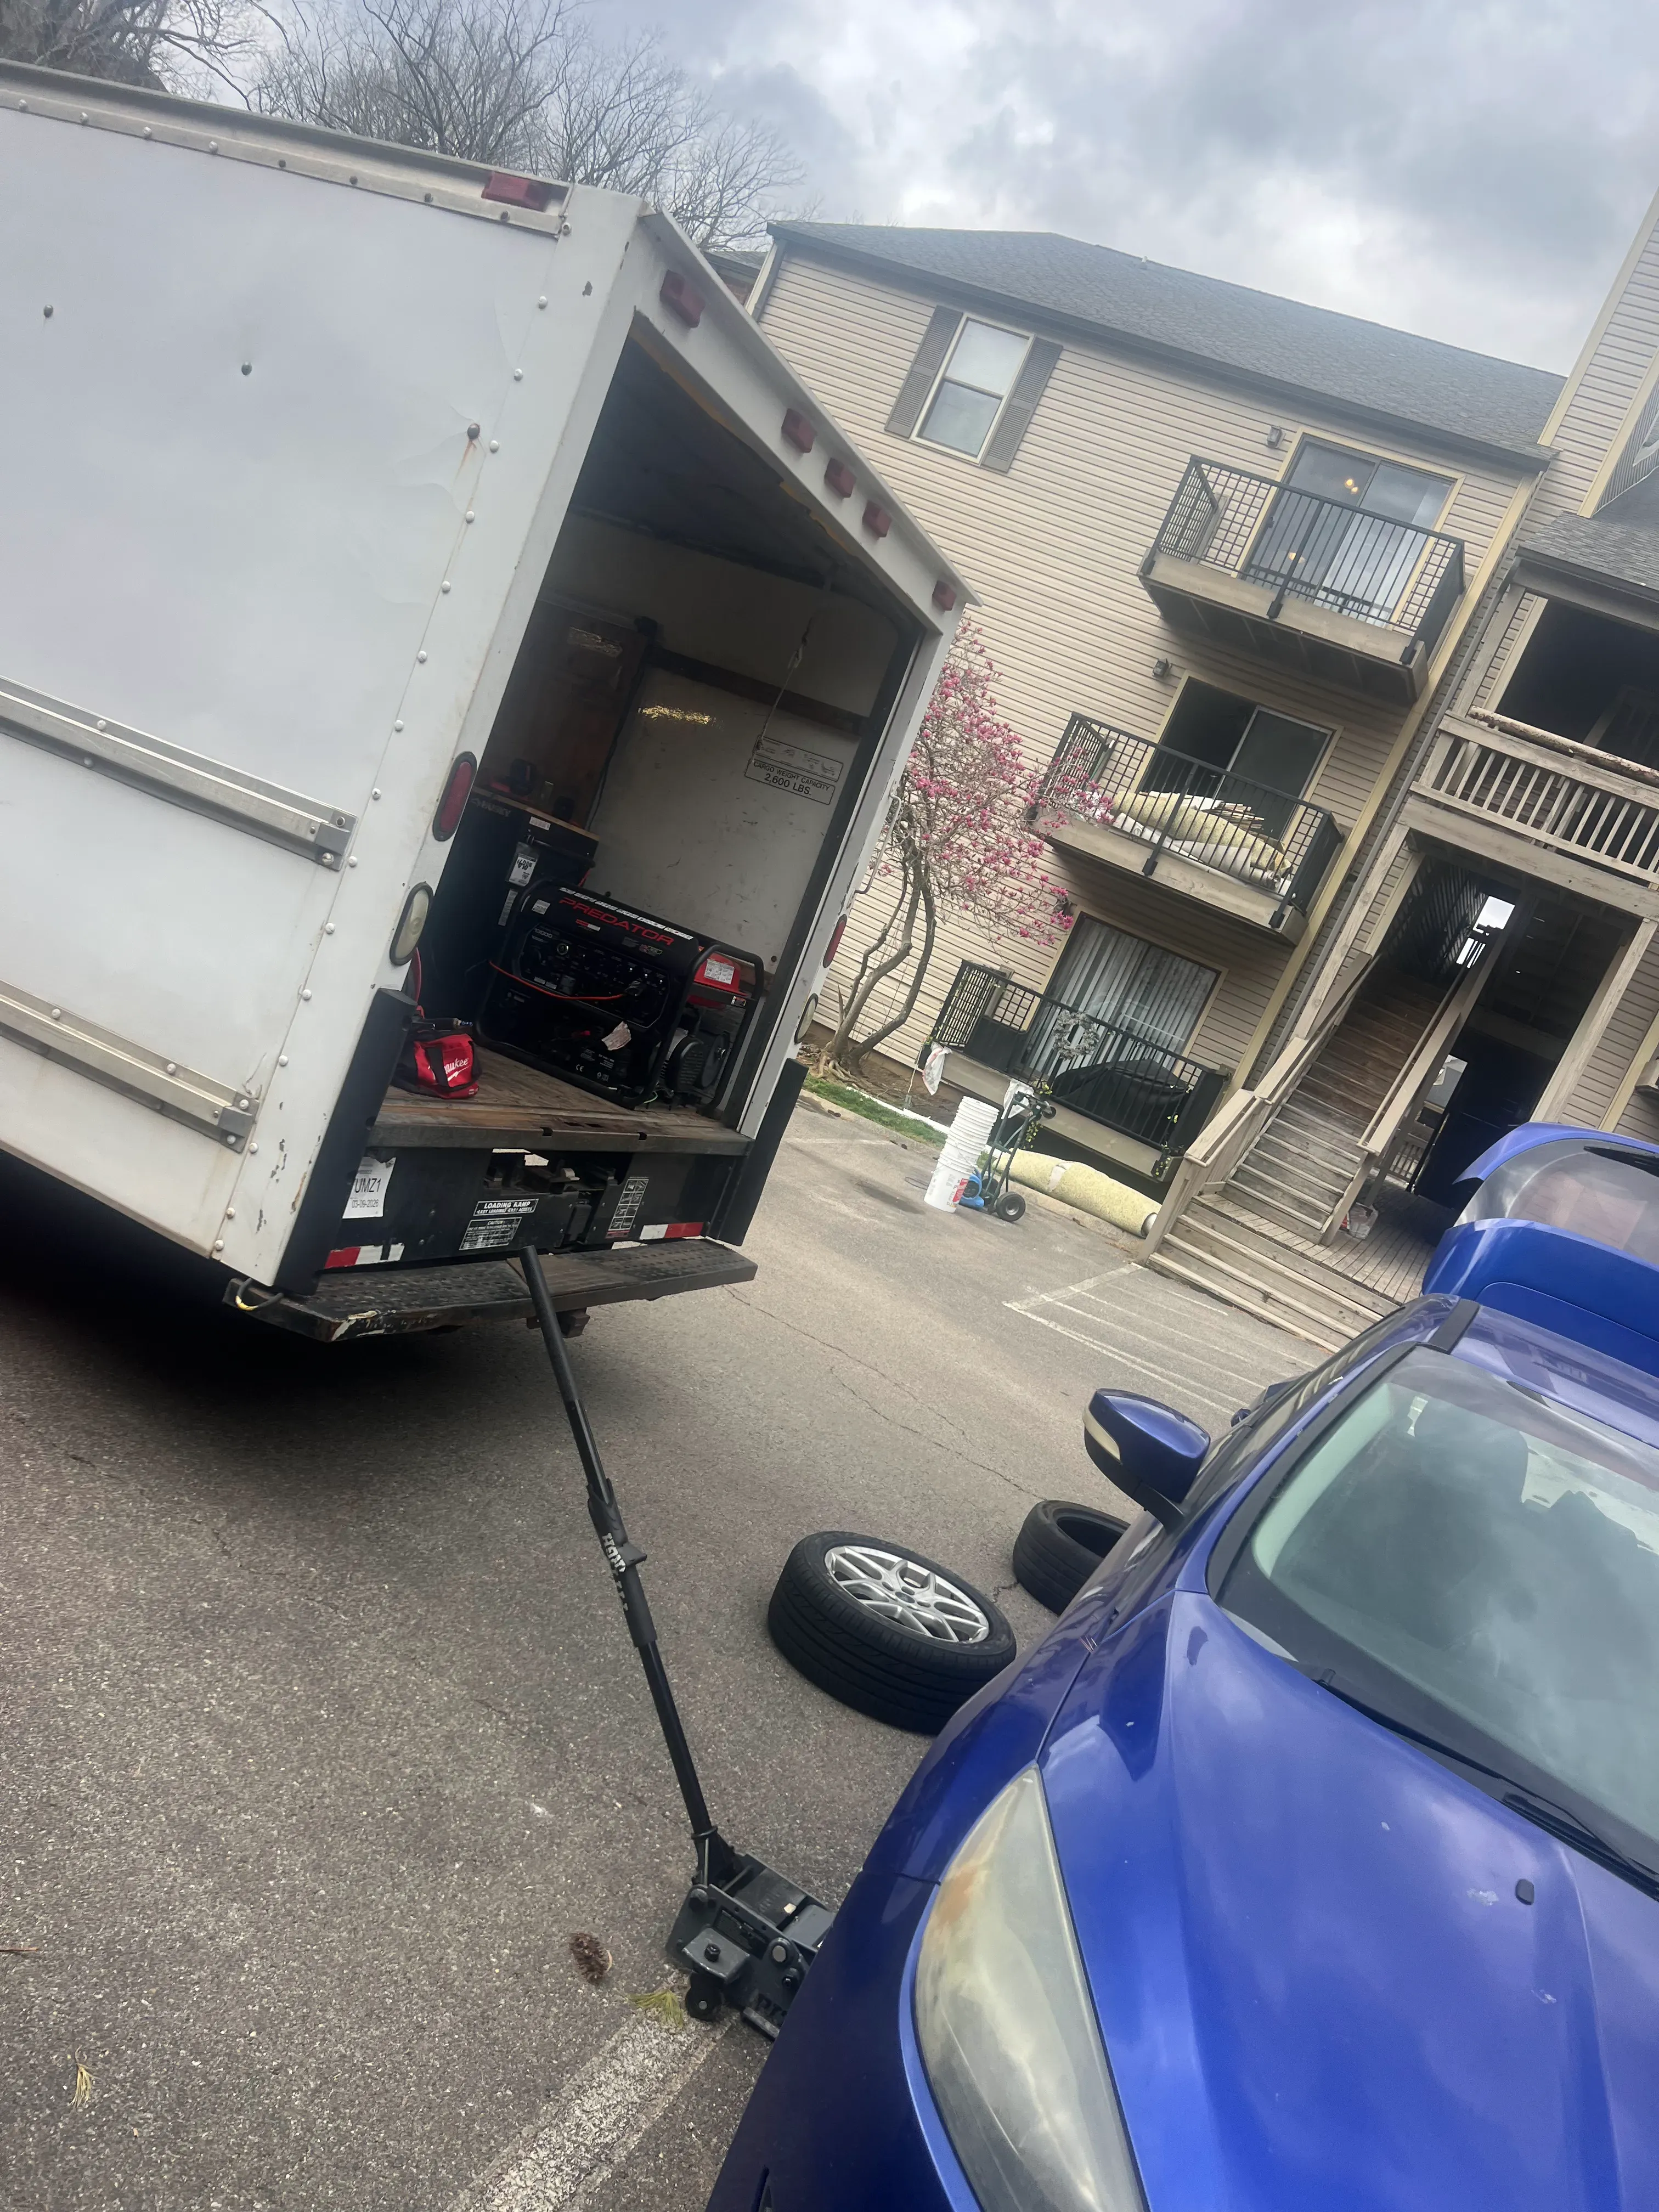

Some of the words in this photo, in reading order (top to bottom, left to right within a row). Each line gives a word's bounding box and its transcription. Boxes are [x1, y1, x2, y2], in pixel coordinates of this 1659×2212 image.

[753, 761, 775, 772] CARGO
[776, 769, 800, 781] WEIGHT
[801, 777, 831, 791] CAPACITY
[764, 773, 790, 788] 2,600
[792, 782, 812, 795] LBS.
[558, 897, 674, 945] PREDATOR
